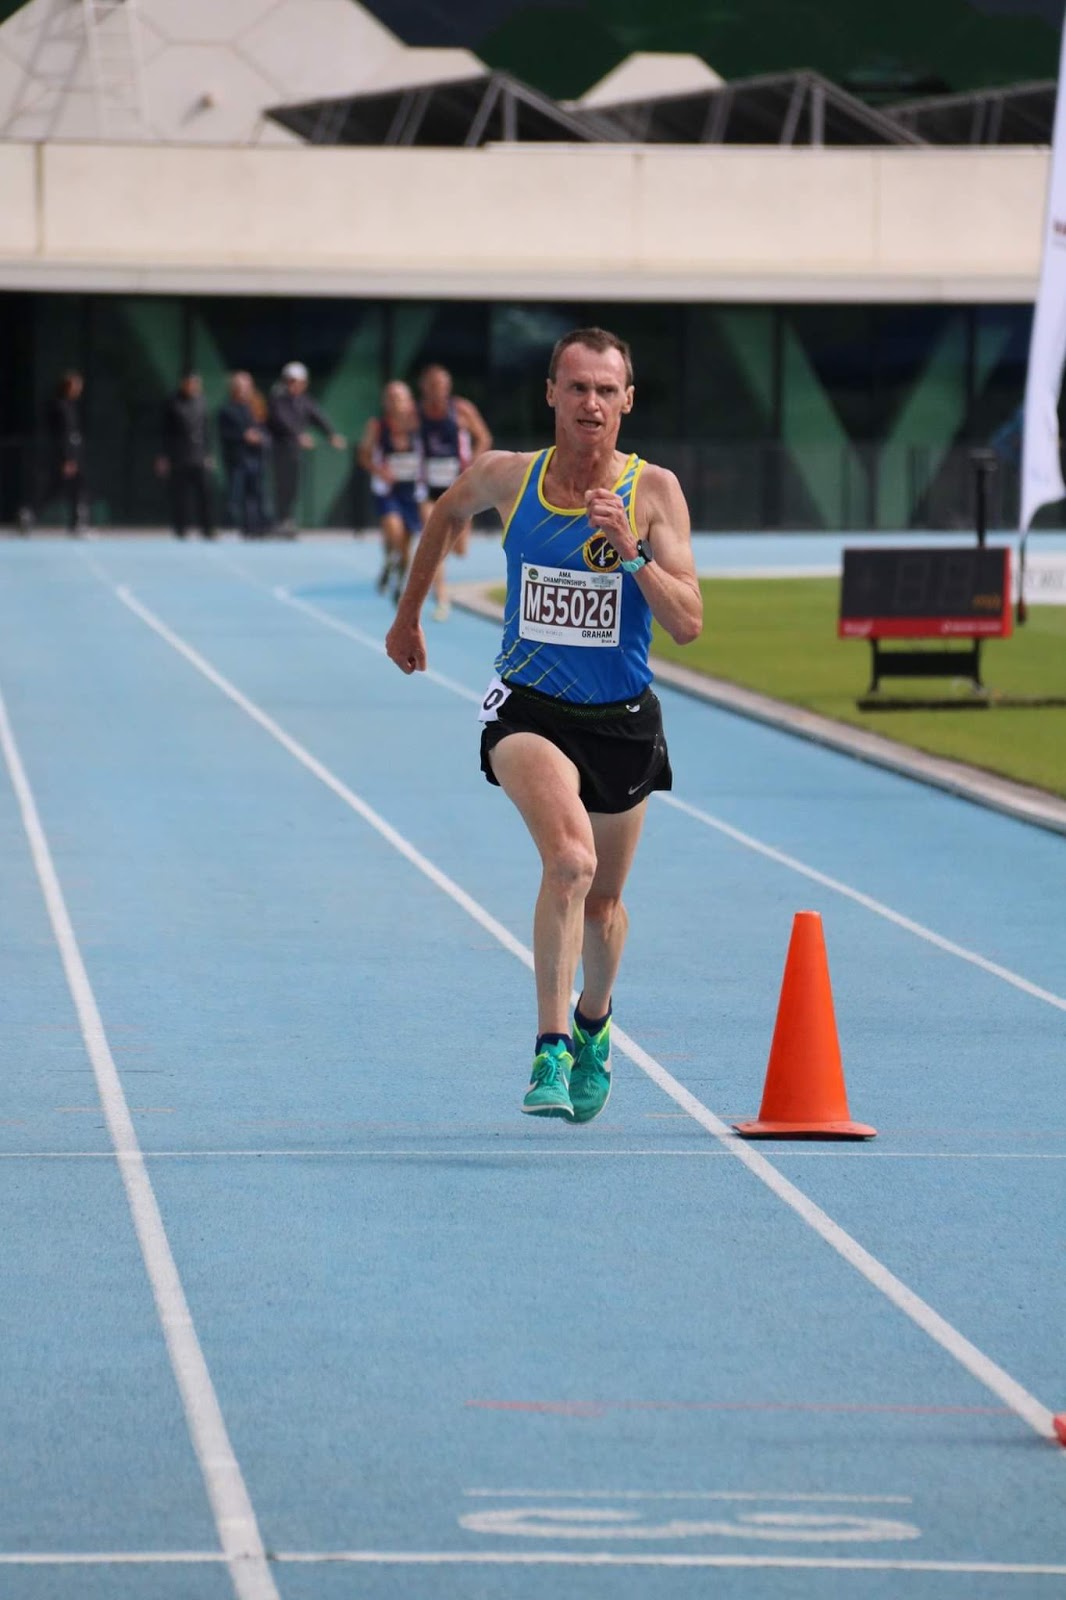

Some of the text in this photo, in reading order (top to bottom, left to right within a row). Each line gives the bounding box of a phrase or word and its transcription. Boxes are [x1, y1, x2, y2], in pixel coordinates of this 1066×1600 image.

[543, 576, 587, 587] CHAMPIONSHIPS
[525, 583, 614, 628] M55026
[581, 630, 613, 639] GRAHAM
